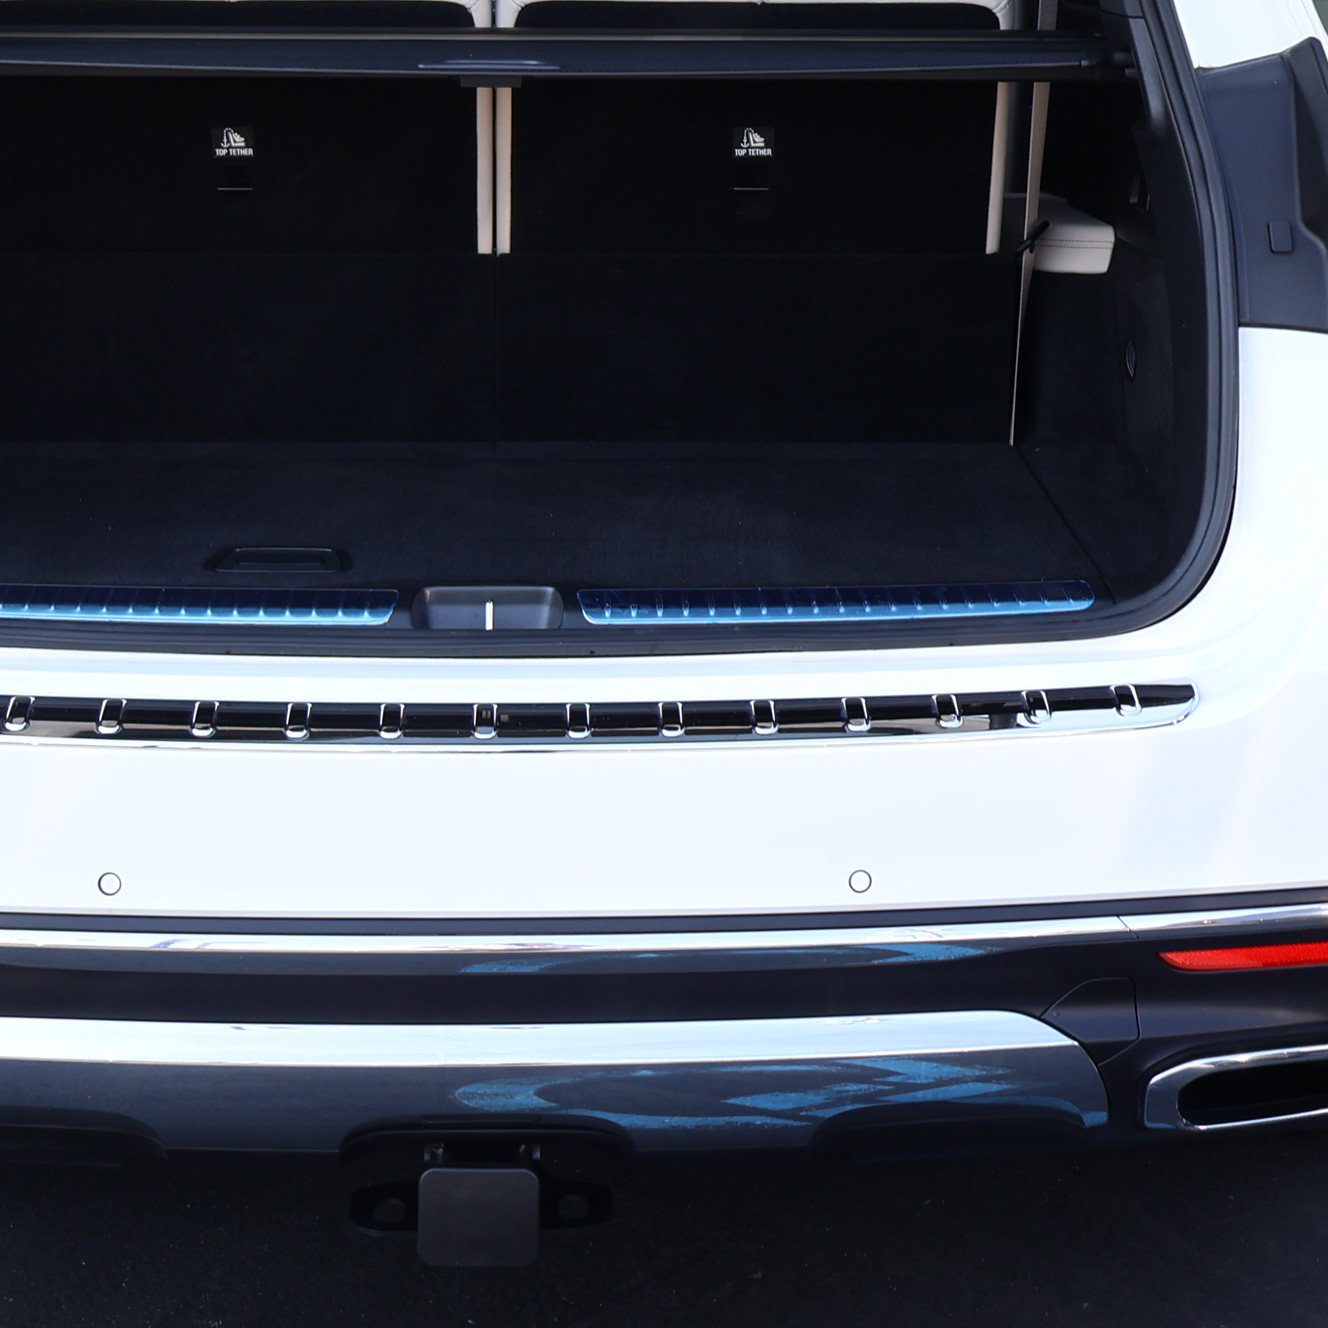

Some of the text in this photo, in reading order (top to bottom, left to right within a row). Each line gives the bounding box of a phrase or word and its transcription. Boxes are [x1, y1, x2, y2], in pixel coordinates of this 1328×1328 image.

[215, 148, 253, 156] TOP TETHER
[735, 148, 772, 156] TOP TETHER
